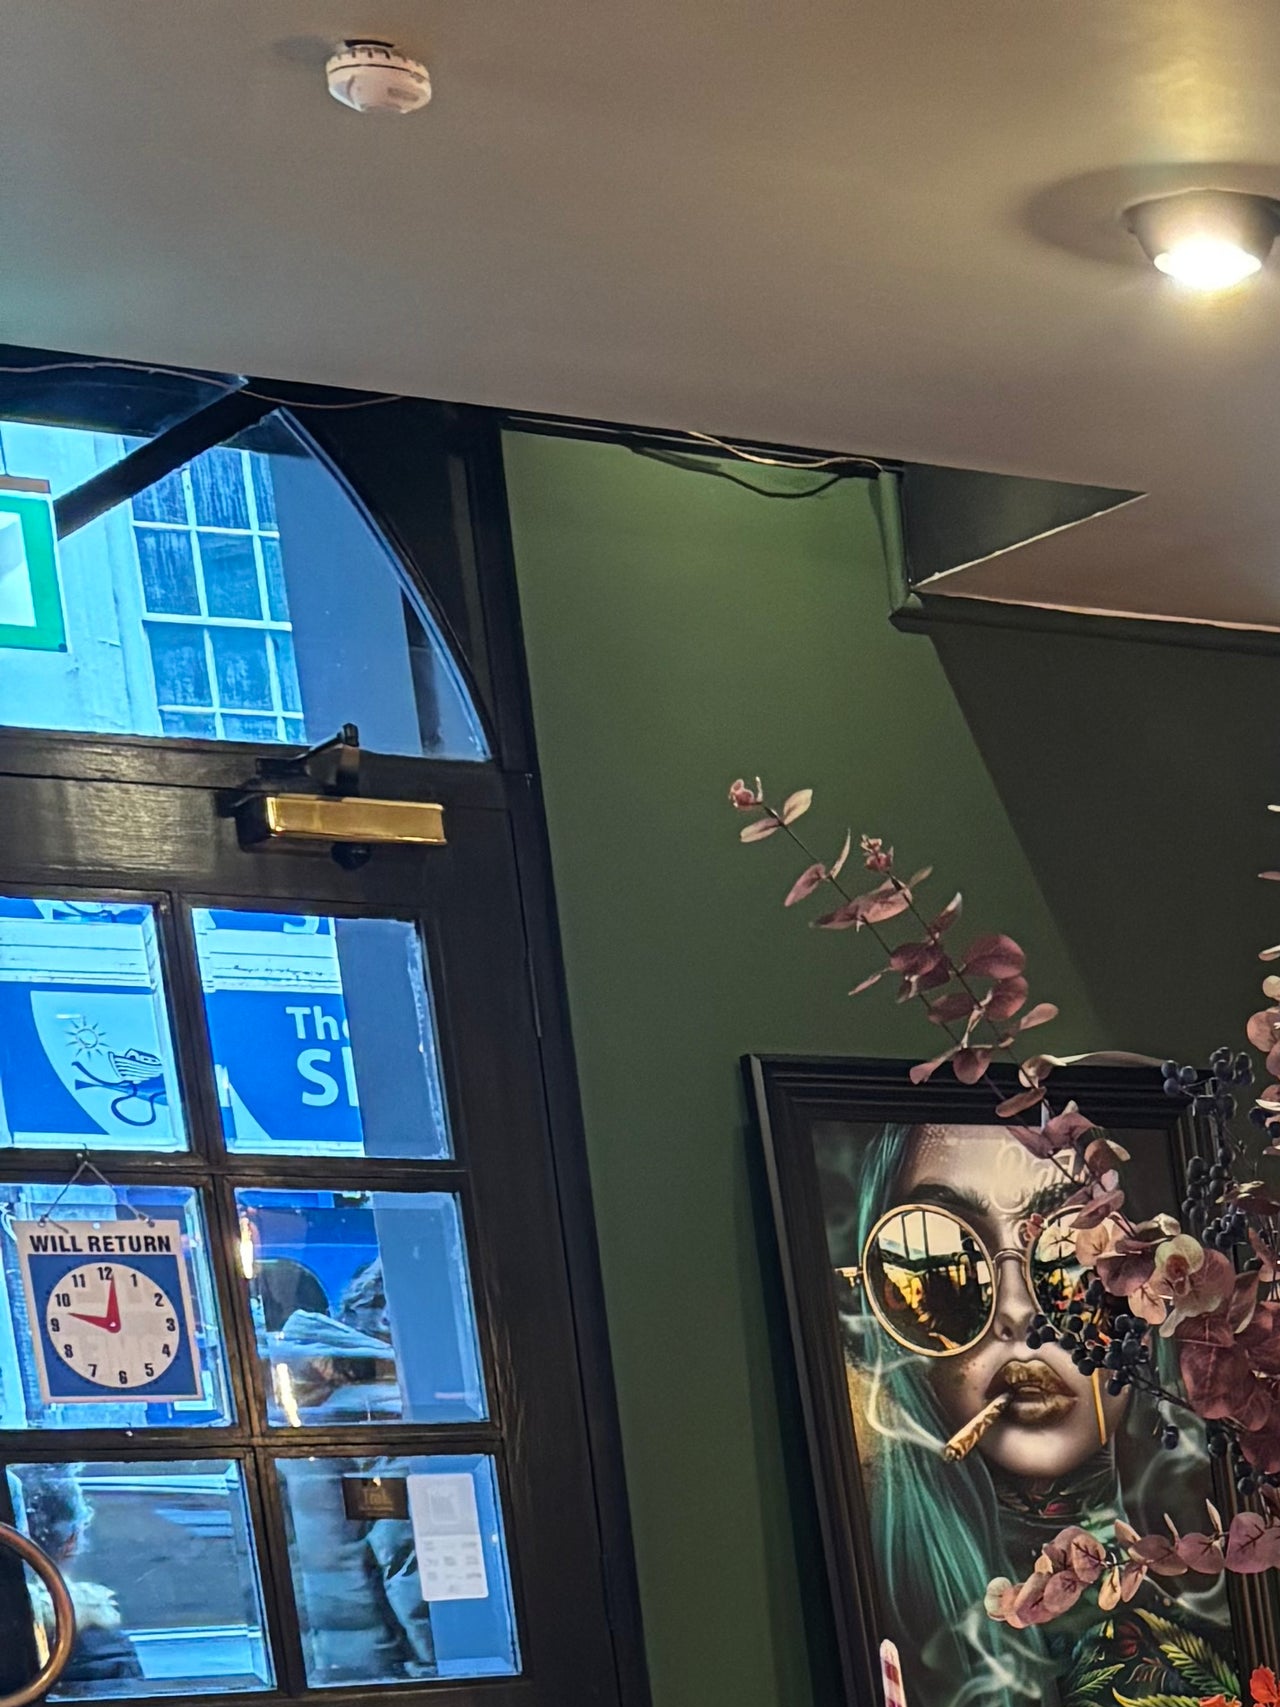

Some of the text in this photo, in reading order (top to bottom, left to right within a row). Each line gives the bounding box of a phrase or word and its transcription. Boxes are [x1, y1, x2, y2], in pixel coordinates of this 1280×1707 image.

[29, 1234, 172, 1253] WILL RETURN
[71, 1273, 86, 1288] 11
[97, 1266, 113, 1281] 12
[130, 1273, 138, 1287] 1
[54, 1293, 71, 1307] 10
[154, 1292, 164, 1307] 2
[50, 1317, 60, 1332] 9
[165, 1317, 176, 1333] 3
[63, 1344, 74, 1358] 8
[161, 1343, 172, 1358] 4
[87, 1363, 98, 1378] 7
[144, 1362, 155, 1377] 5
[118, 1370, 128, 1385] 6
